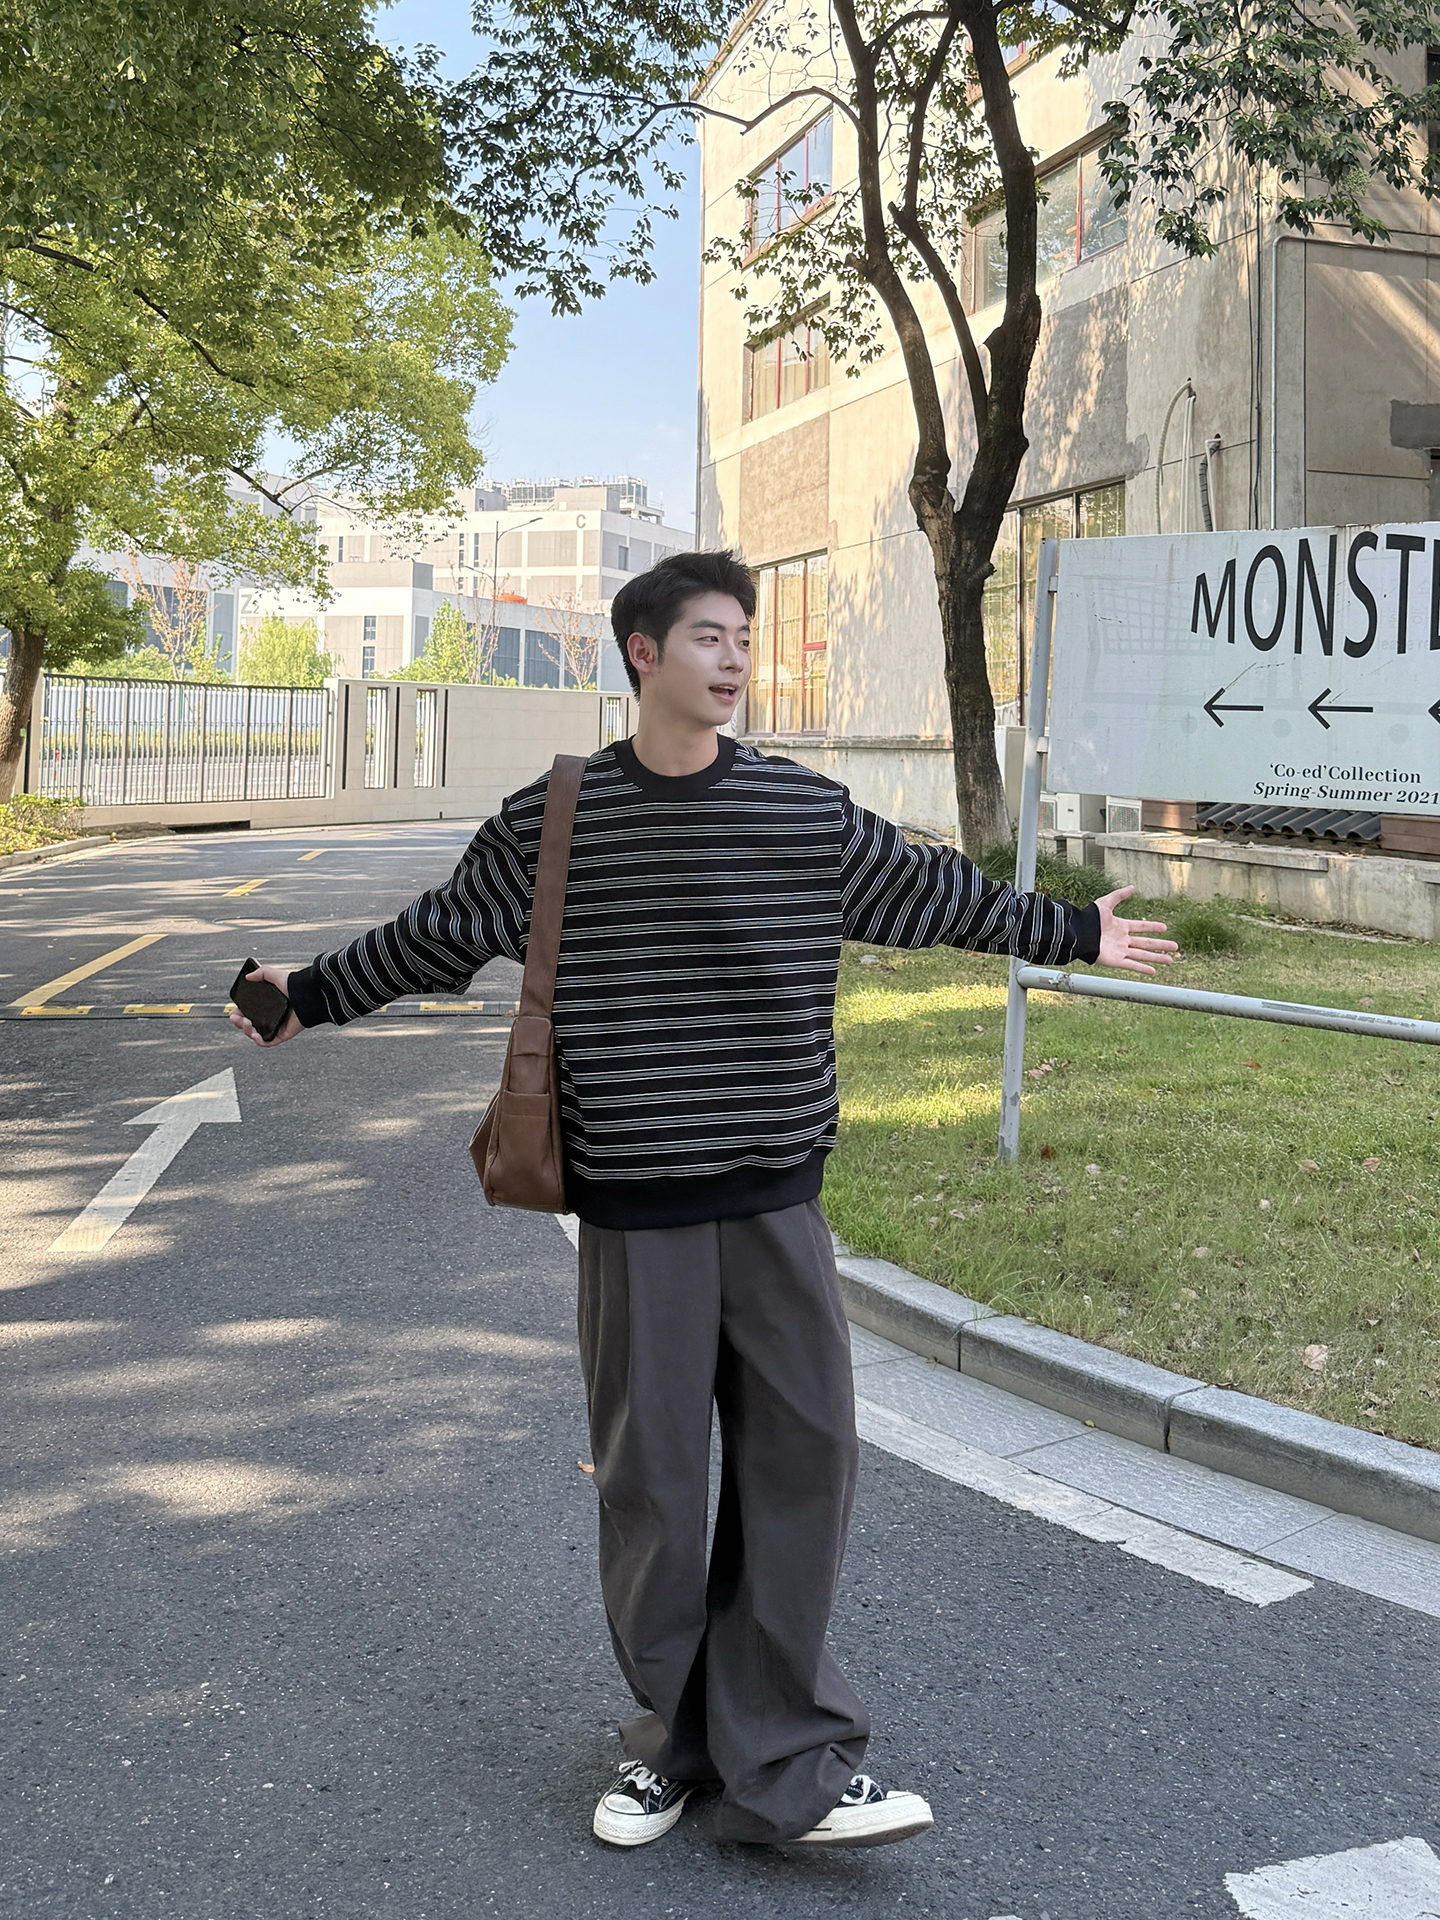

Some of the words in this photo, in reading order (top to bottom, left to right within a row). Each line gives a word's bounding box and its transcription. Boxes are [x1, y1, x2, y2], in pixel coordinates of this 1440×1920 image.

[576, 513, 587, 529] C
[1253, 781, 1393, 805] Spring-Summer
[1396, 790, 1440, 805] 2021
